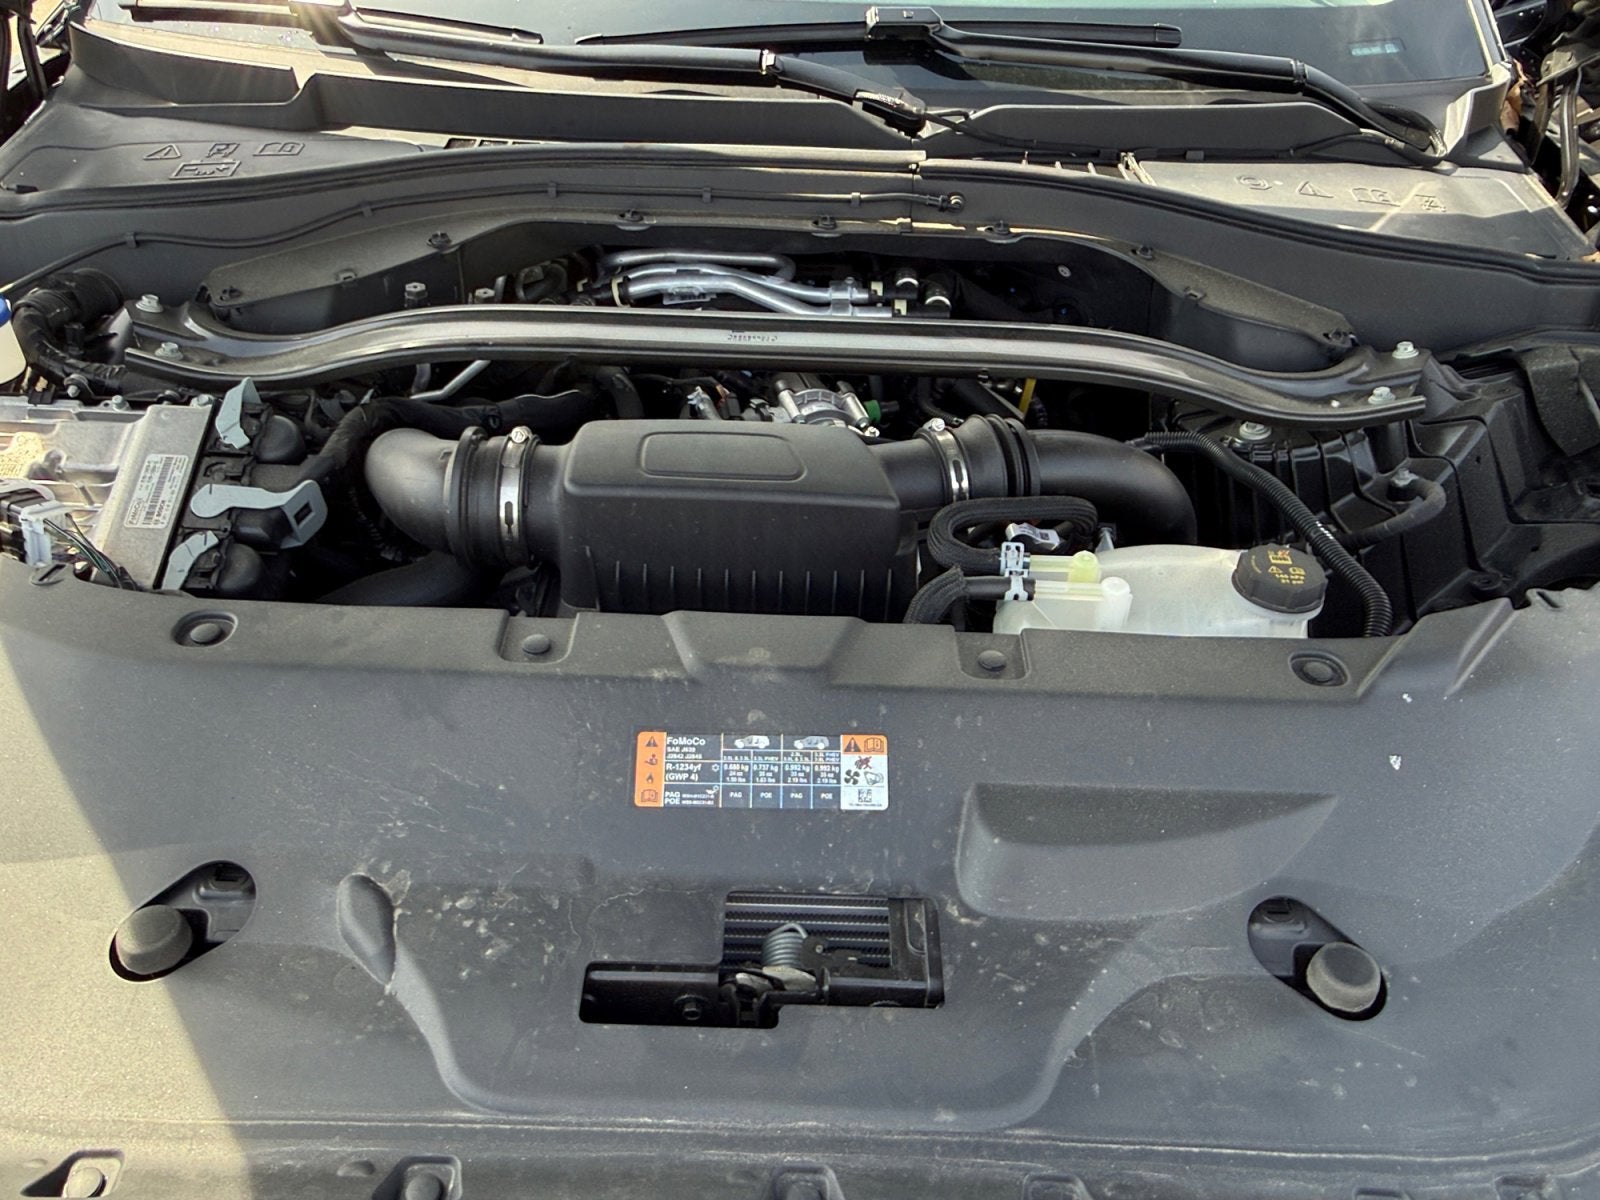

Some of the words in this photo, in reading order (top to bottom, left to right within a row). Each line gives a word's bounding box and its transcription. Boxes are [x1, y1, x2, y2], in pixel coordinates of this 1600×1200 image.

[666, 736, 706, 746] FoMoCo
[666, 763, 702, 772] R-1234yf
[770, 764, 779, 772] kg
[802, 764, 810, 772] kg
